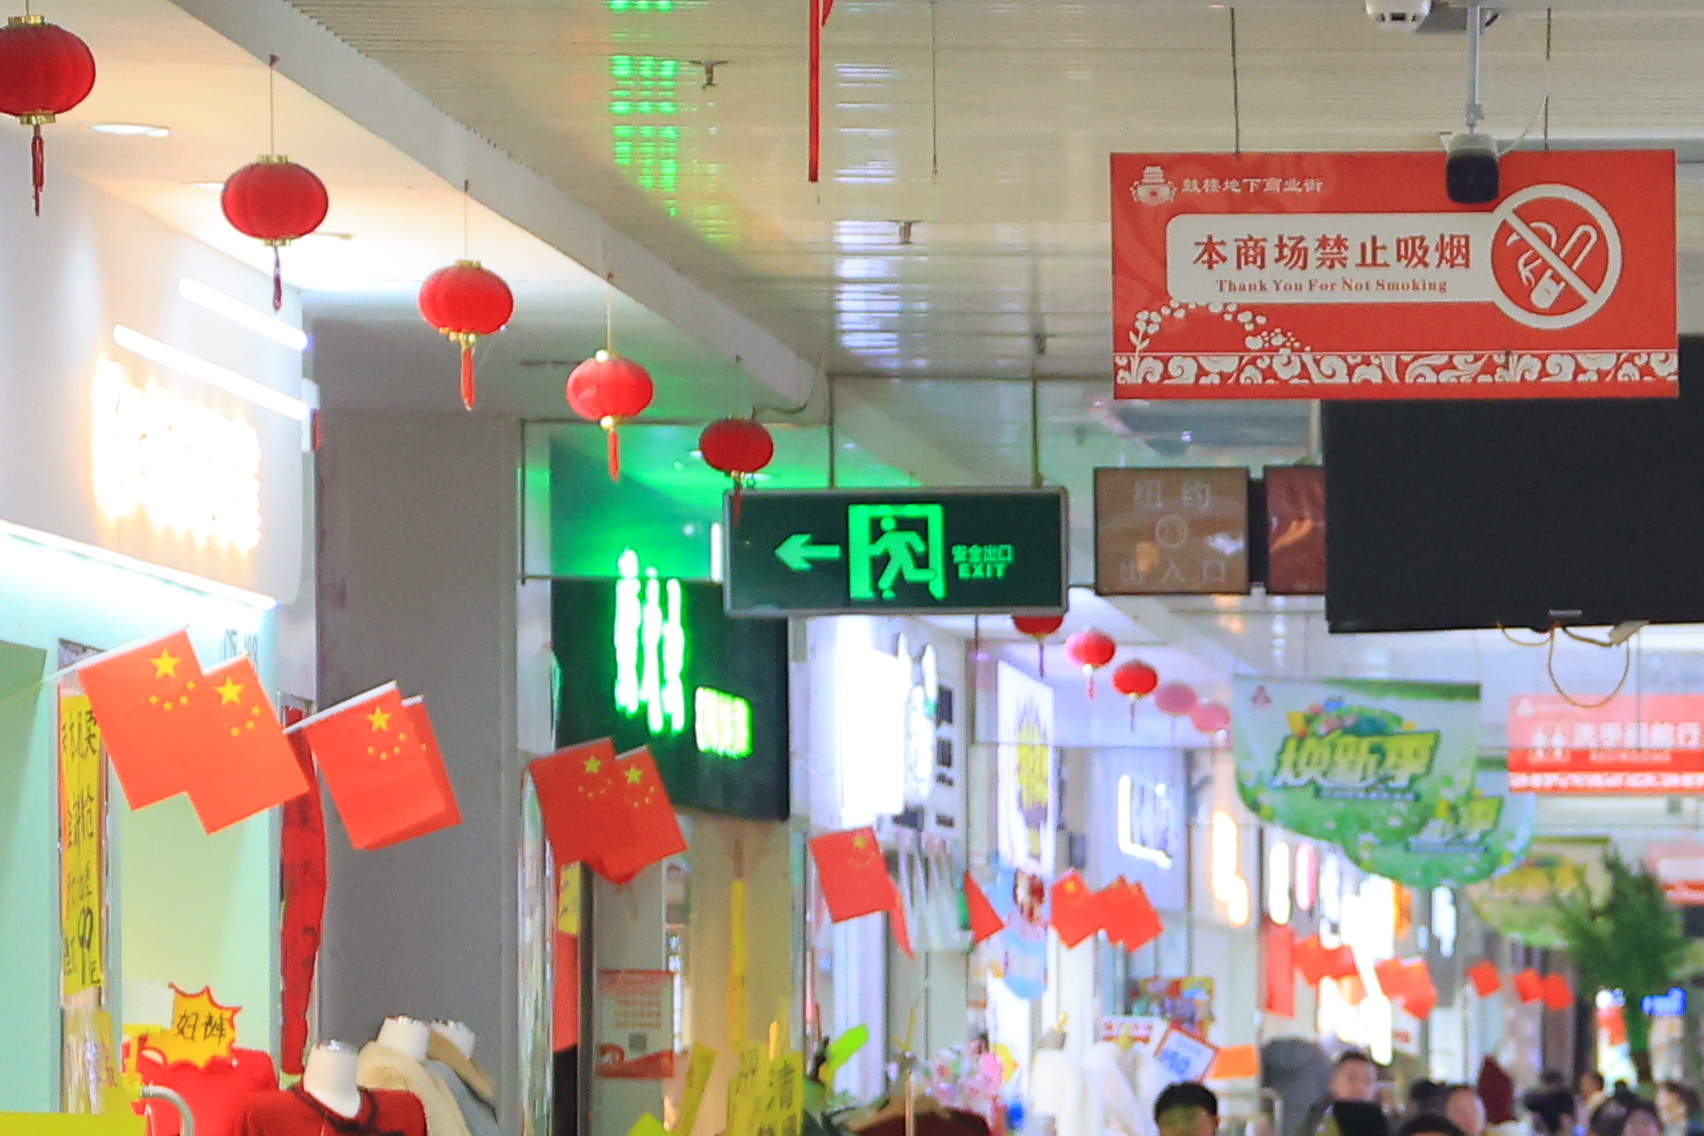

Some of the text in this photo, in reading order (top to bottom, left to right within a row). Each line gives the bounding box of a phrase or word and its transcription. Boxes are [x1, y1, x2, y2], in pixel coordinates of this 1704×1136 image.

[1192, 233, 1472, 271] 本商场禁止吸烟
[1216, 277, 1449, 293] Thank You For Not Smoking
[952, 543, 1014, 563] 安全出口
[958, 563, 1007, 579] EXIT
